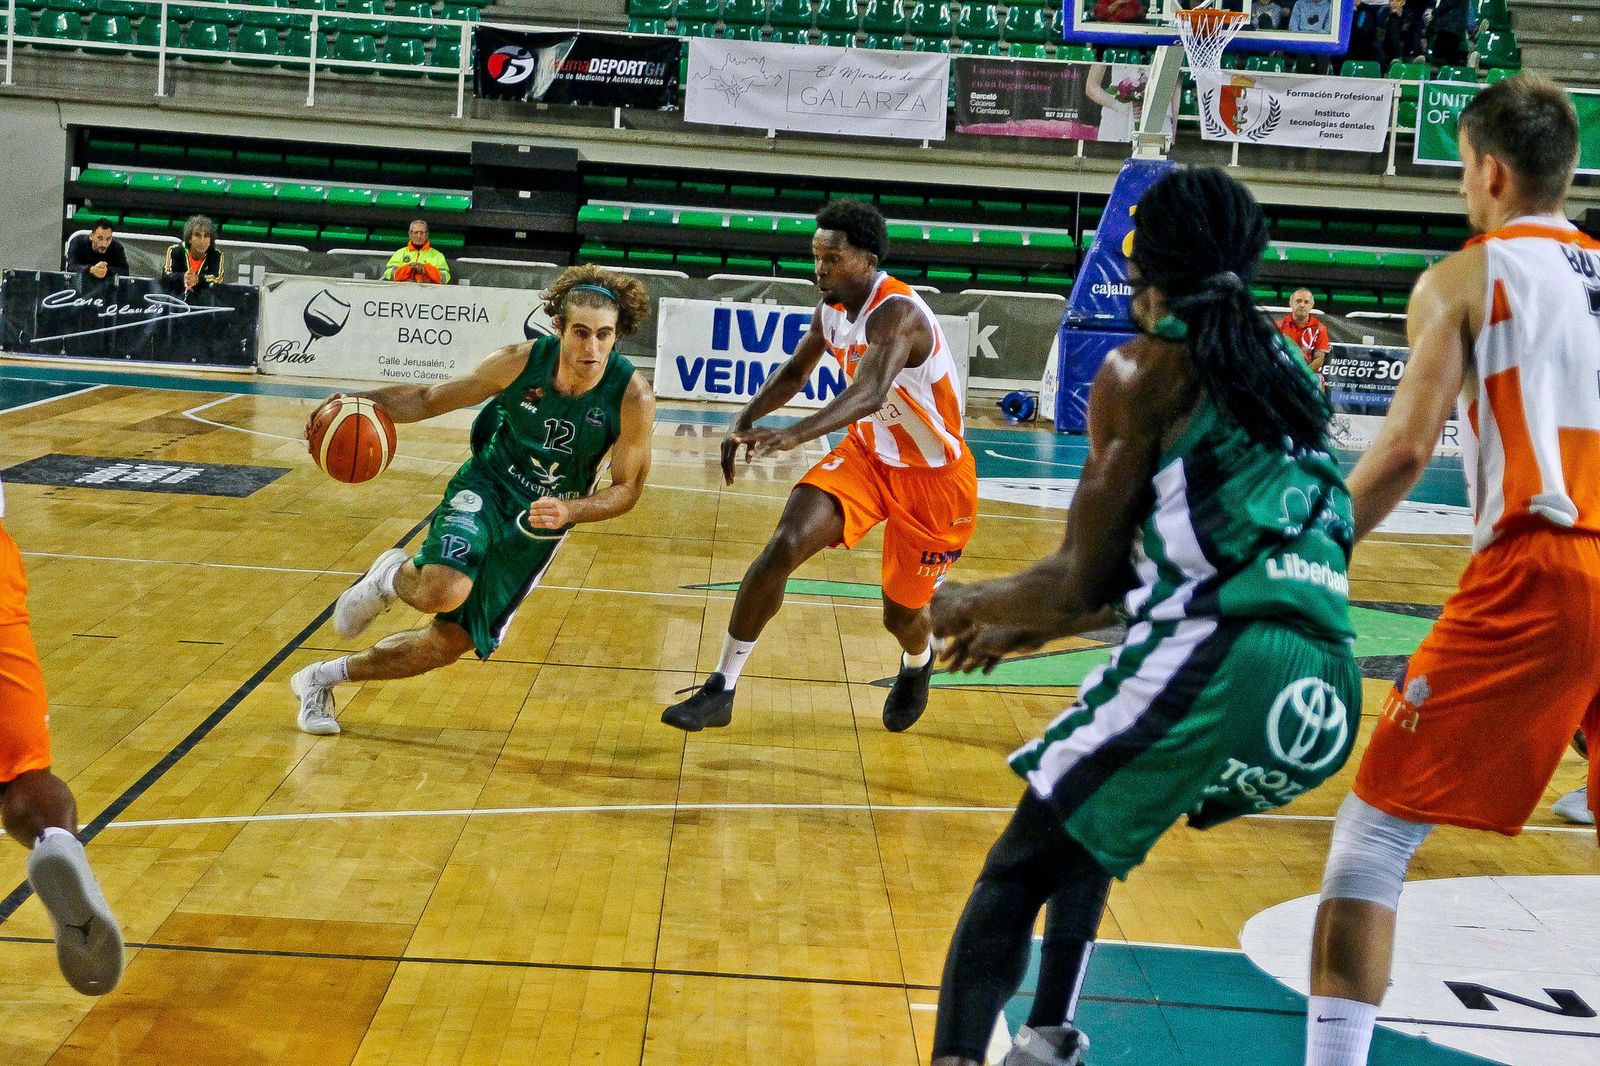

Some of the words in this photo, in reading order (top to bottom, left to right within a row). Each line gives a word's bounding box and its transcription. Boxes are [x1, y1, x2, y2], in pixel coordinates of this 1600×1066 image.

[575, 74, 604, 82] Medicina
[816, 64, 834, 78] El
[840, 66, 896, 85] Mirador
[801, 86, 927, 112] GALARZA
[970, 92, 998, 100] Barceló
[1286, 89, 1333, 100] Formación
[1334, 91, 1384, 102] Profesional
[976, 106, 1010, 115] Centenario
[1314, 109, 1351, 118] Instituto
[1427, 109, 1450, 124] OF
[1339, 121, 1376, 131] dentales
[1318, 130, 1344, 140] Fones
[363, 299, 489, 323] CERVECERÍA
[397, 327, 453, 346] BACO
[711, 307, 814, 355] IVE
[263, 339, 316, 364] Baco
[378, 355, 401, 366] Calle
[449, 360, 455, 368] 2
[1330, 358, 1359, 366] NUEVO
[1375, 360, 1405, 380] 30
[675, 355, 847, 401] VEIMN
[543, 418, 576, 454] 12
[440, 533, 471, 566] 12
